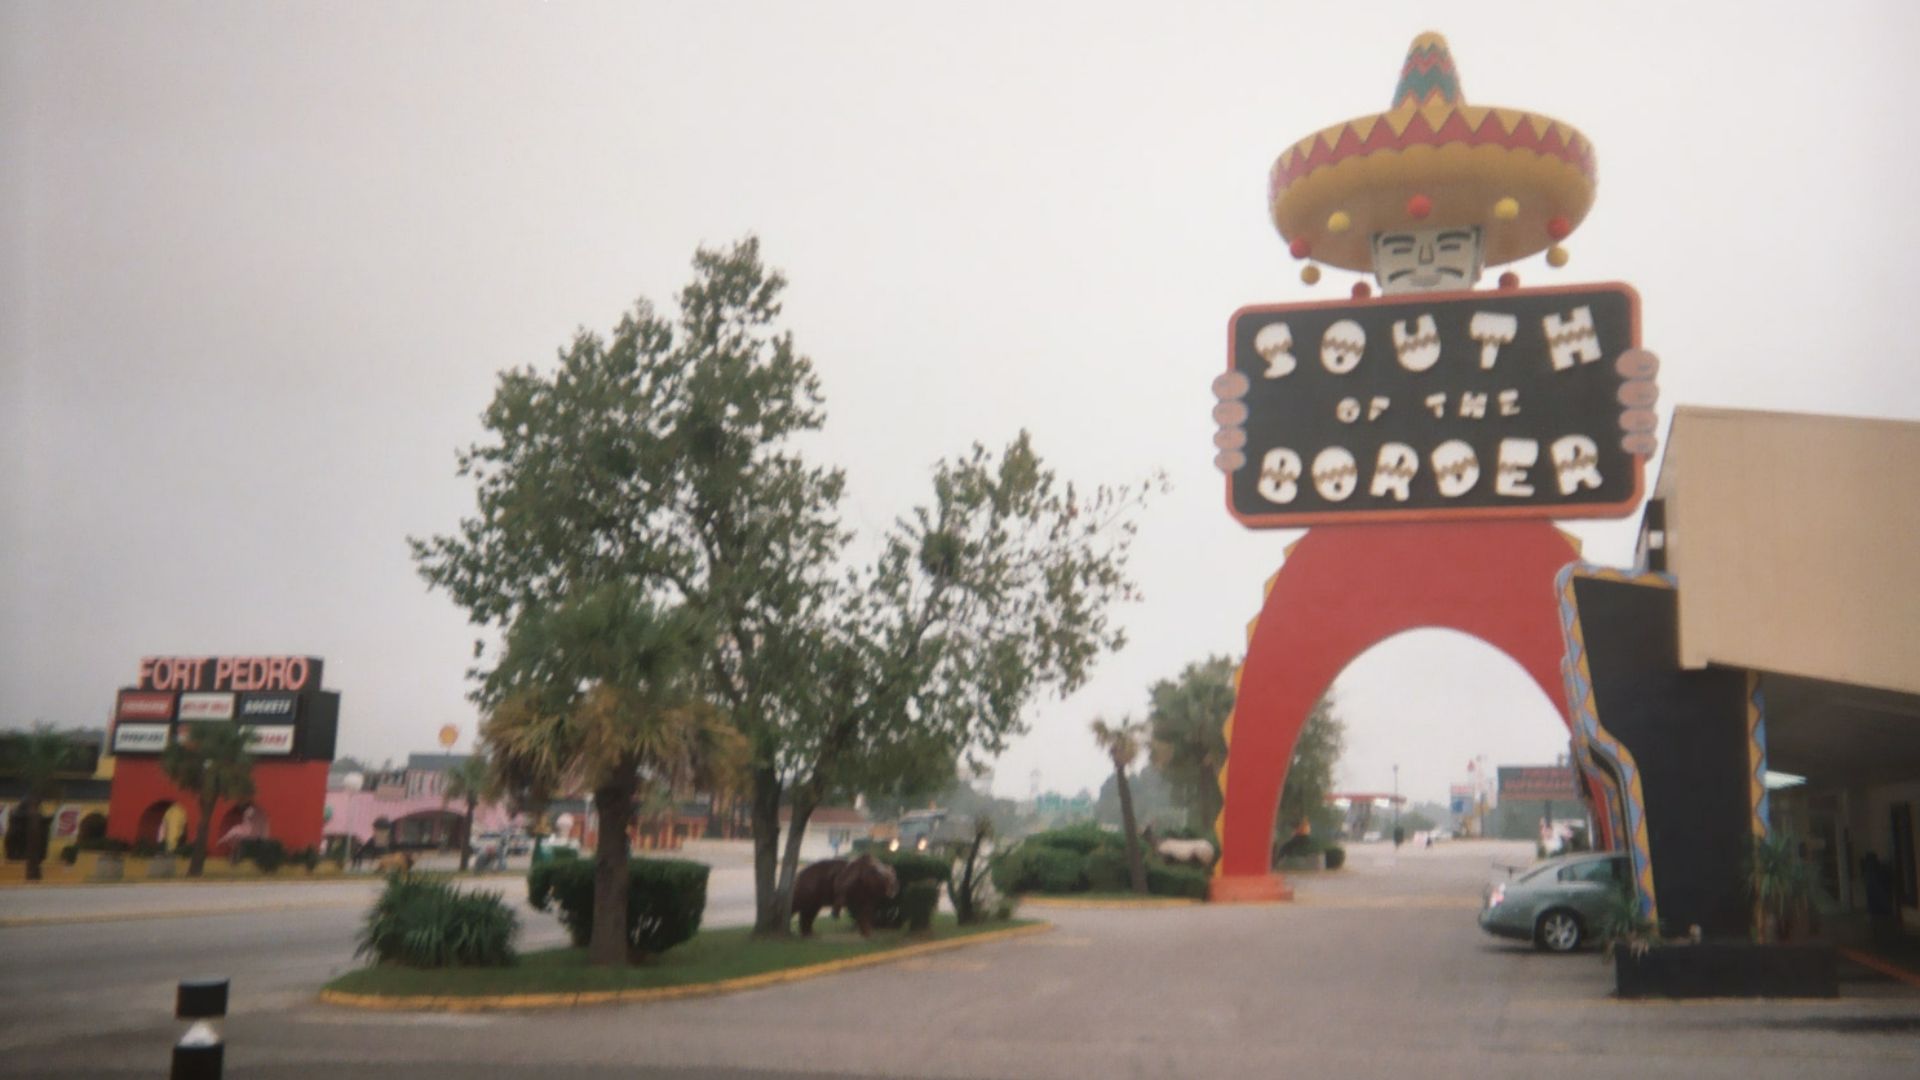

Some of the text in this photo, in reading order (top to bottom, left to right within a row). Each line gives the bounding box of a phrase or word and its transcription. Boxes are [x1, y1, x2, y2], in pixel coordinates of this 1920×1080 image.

[1254, 305, 1603, 379] SOUTH
[1336, 389, 1521, 423] OF THE
[1257, 434, 1603, 504] BORDER
[137, 656, 310, 691] FORT PEDRO
